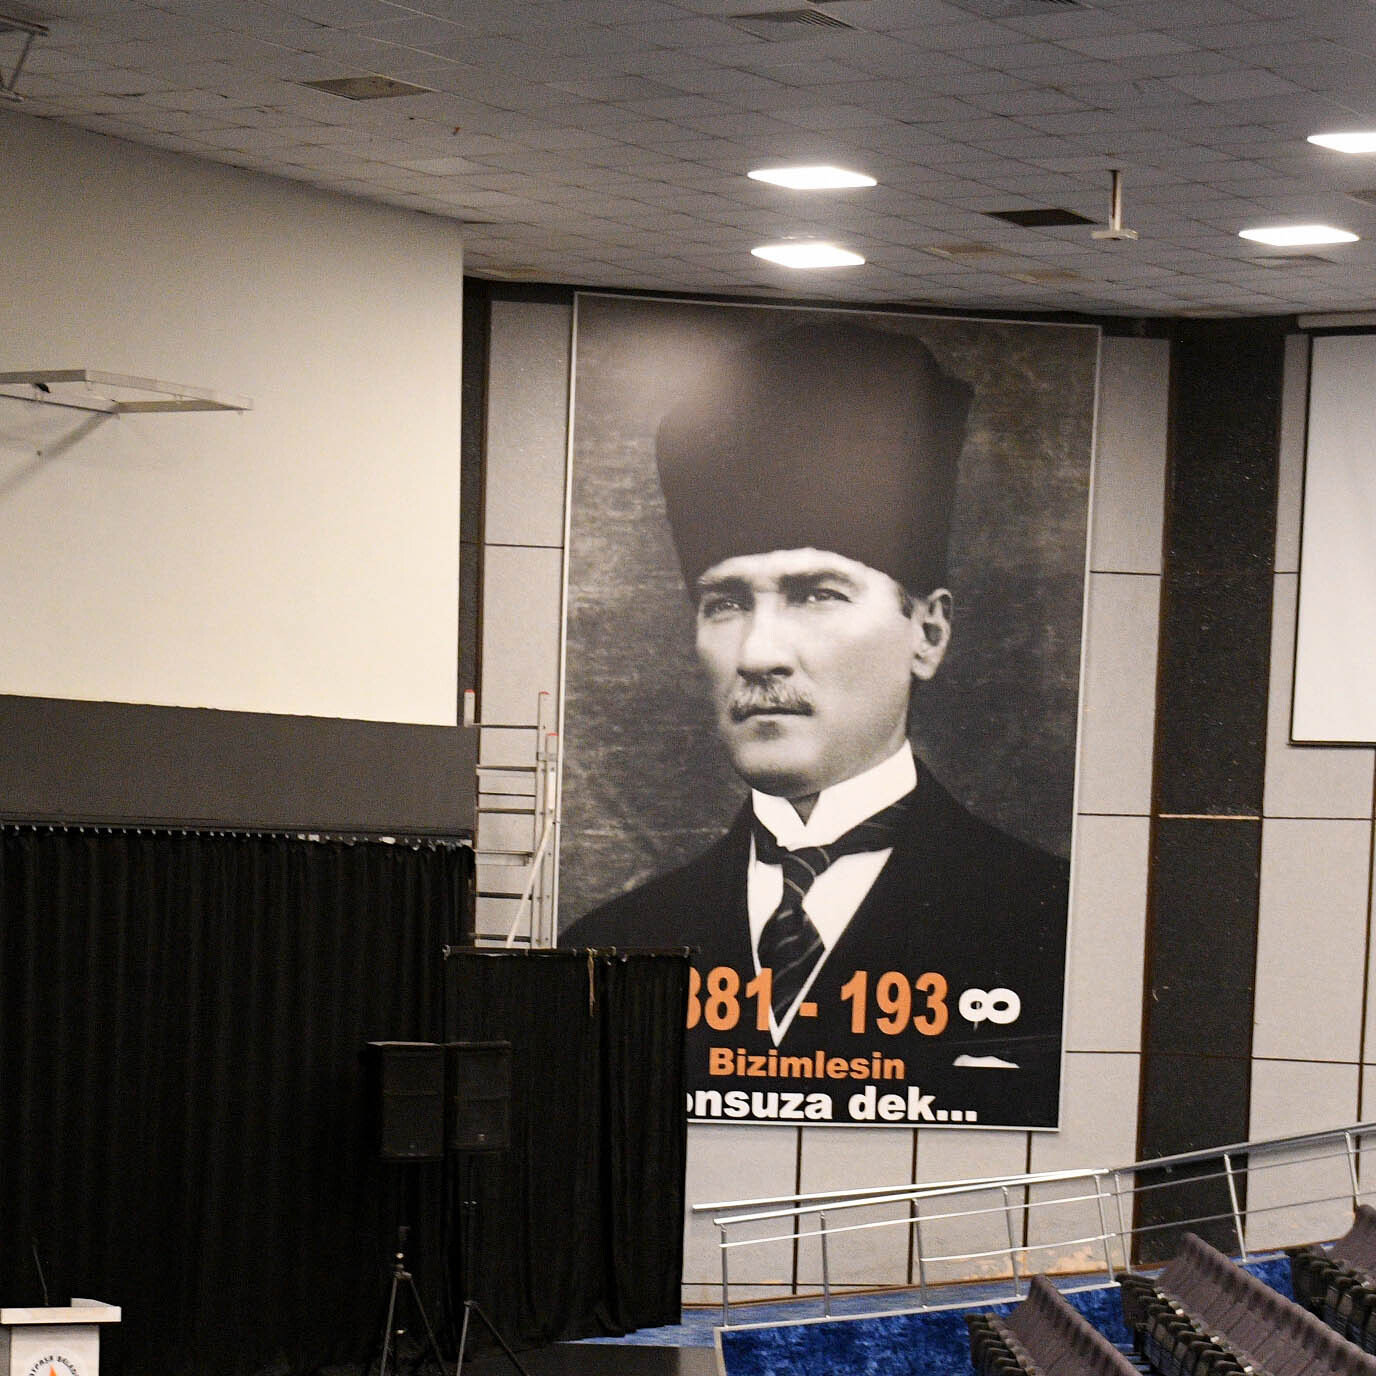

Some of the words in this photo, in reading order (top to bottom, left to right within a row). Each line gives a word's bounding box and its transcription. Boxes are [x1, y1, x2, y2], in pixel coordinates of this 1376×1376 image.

[709, 1047, 906, 1080] Bizimlesin
[687, 1090, 833, 1120] nsuza
[847, 1085, 978, 1122] dek...
